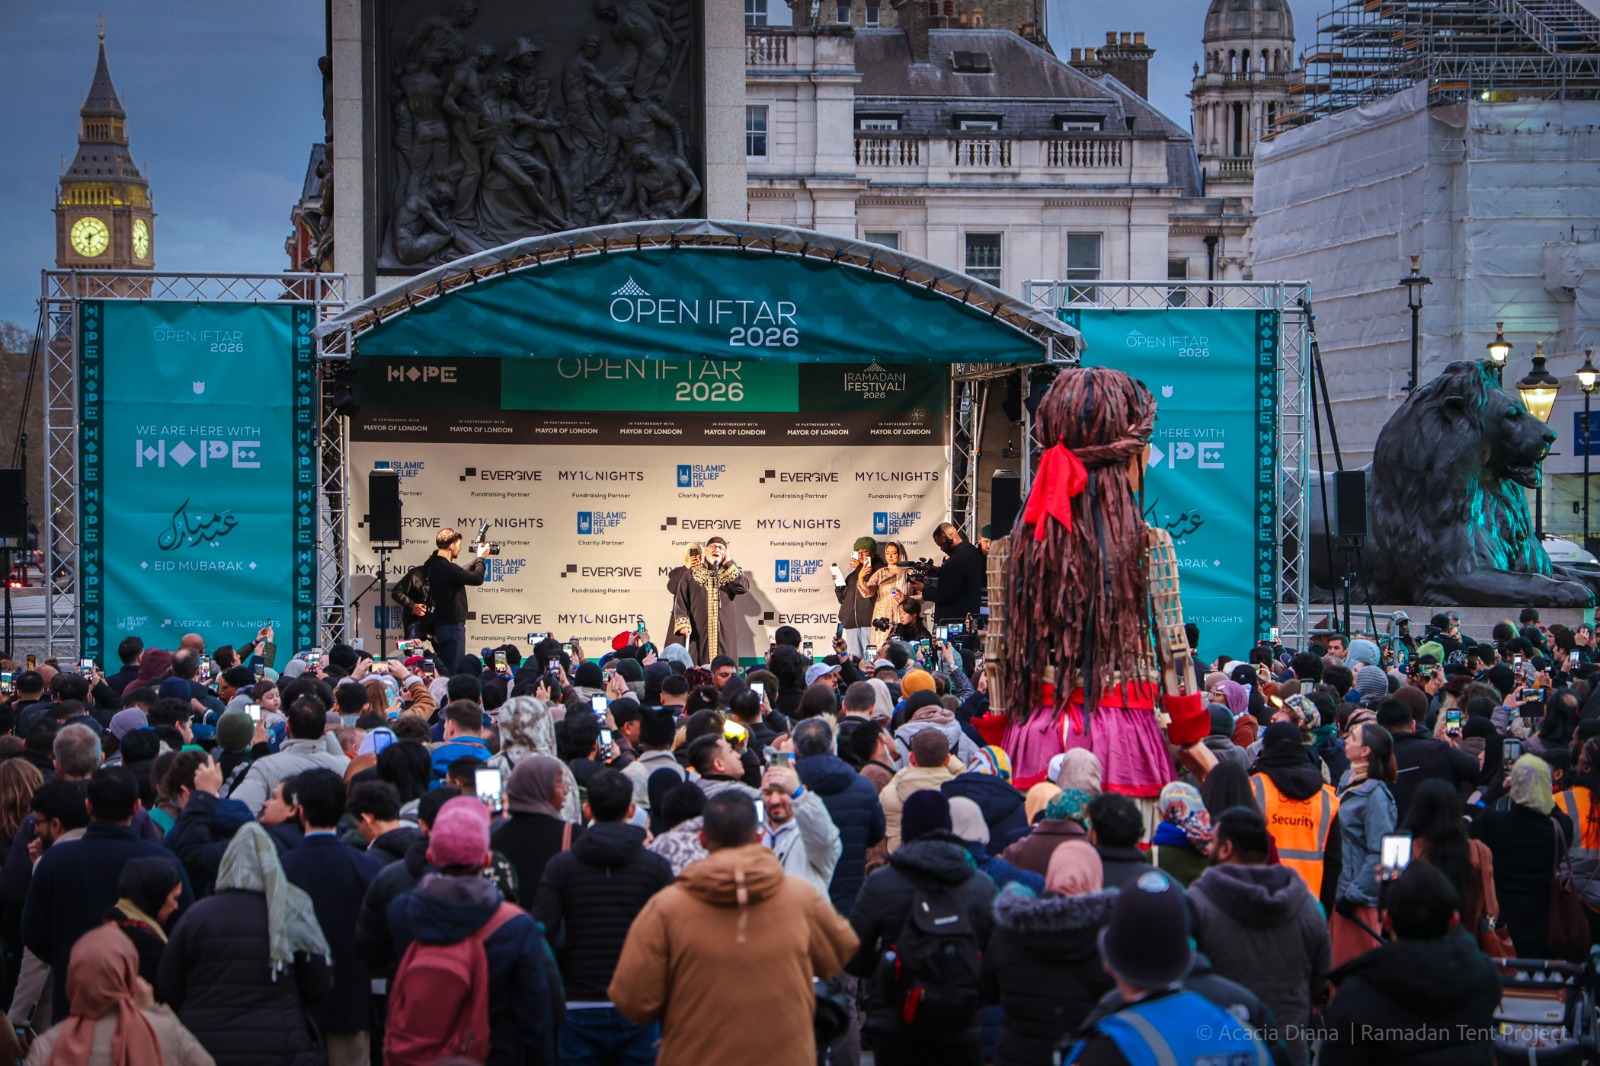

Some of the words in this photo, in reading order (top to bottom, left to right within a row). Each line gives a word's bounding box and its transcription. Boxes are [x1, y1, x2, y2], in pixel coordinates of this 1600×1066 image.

[609, 297, 698, 323] OPEN
[709, 299, 797, 325] IFTAR
[154, 329, 197, 342] OPEN
[200, 331, 243, 343] IFTAR
[729, 326, 799, 347] 2026
[1126, 336, 1166, 348] OPEN
[1169, 336, 1209, 348] IFTAR
[210, 343, 244, 352] 2026
[1178, 348, 1210, 357] 2026
[847, 373, 902, 382] RAMADAN
[675, 381, 744, 402] 2026
[847, 382, 902, 392] FESTIVAL
[863, 391, 886, 399] 2026
[136, 426, 157, 435] WE
[160, 426, 186, 435] ARE
[190, 426, 224, 436] HERE
[227, 427, 261, 436] WITH
[363, 424, 387, 432] MAYOR
[388, 424, 398, 432] OF
[398, 424, 428, 432] LONDON
[1159, 428, 1190, 438] HERE
[1193, 428, 1225, 438] WITH
[136, 440, 261, 468] HOPE
[391, 461, 425, 469] ISLAMIC
[481, 470, 542, 481] EVERGIVE
[780, 472, 839, 483] EVERGIVE
[681, 519, 742, 530] EVERGIVE
[154, 561, 175, 571] EID
[179, 561, 243, 571] MUBARAK
[492, 566, 519, 574] RELIEF
[582, 567, 642, 577] EVERGIVE
[481, 614, 542, 625] EVERGIVE
[778, 613, 838, 624] EVERGIVE
[1272, 813, 1314, 830] Security
